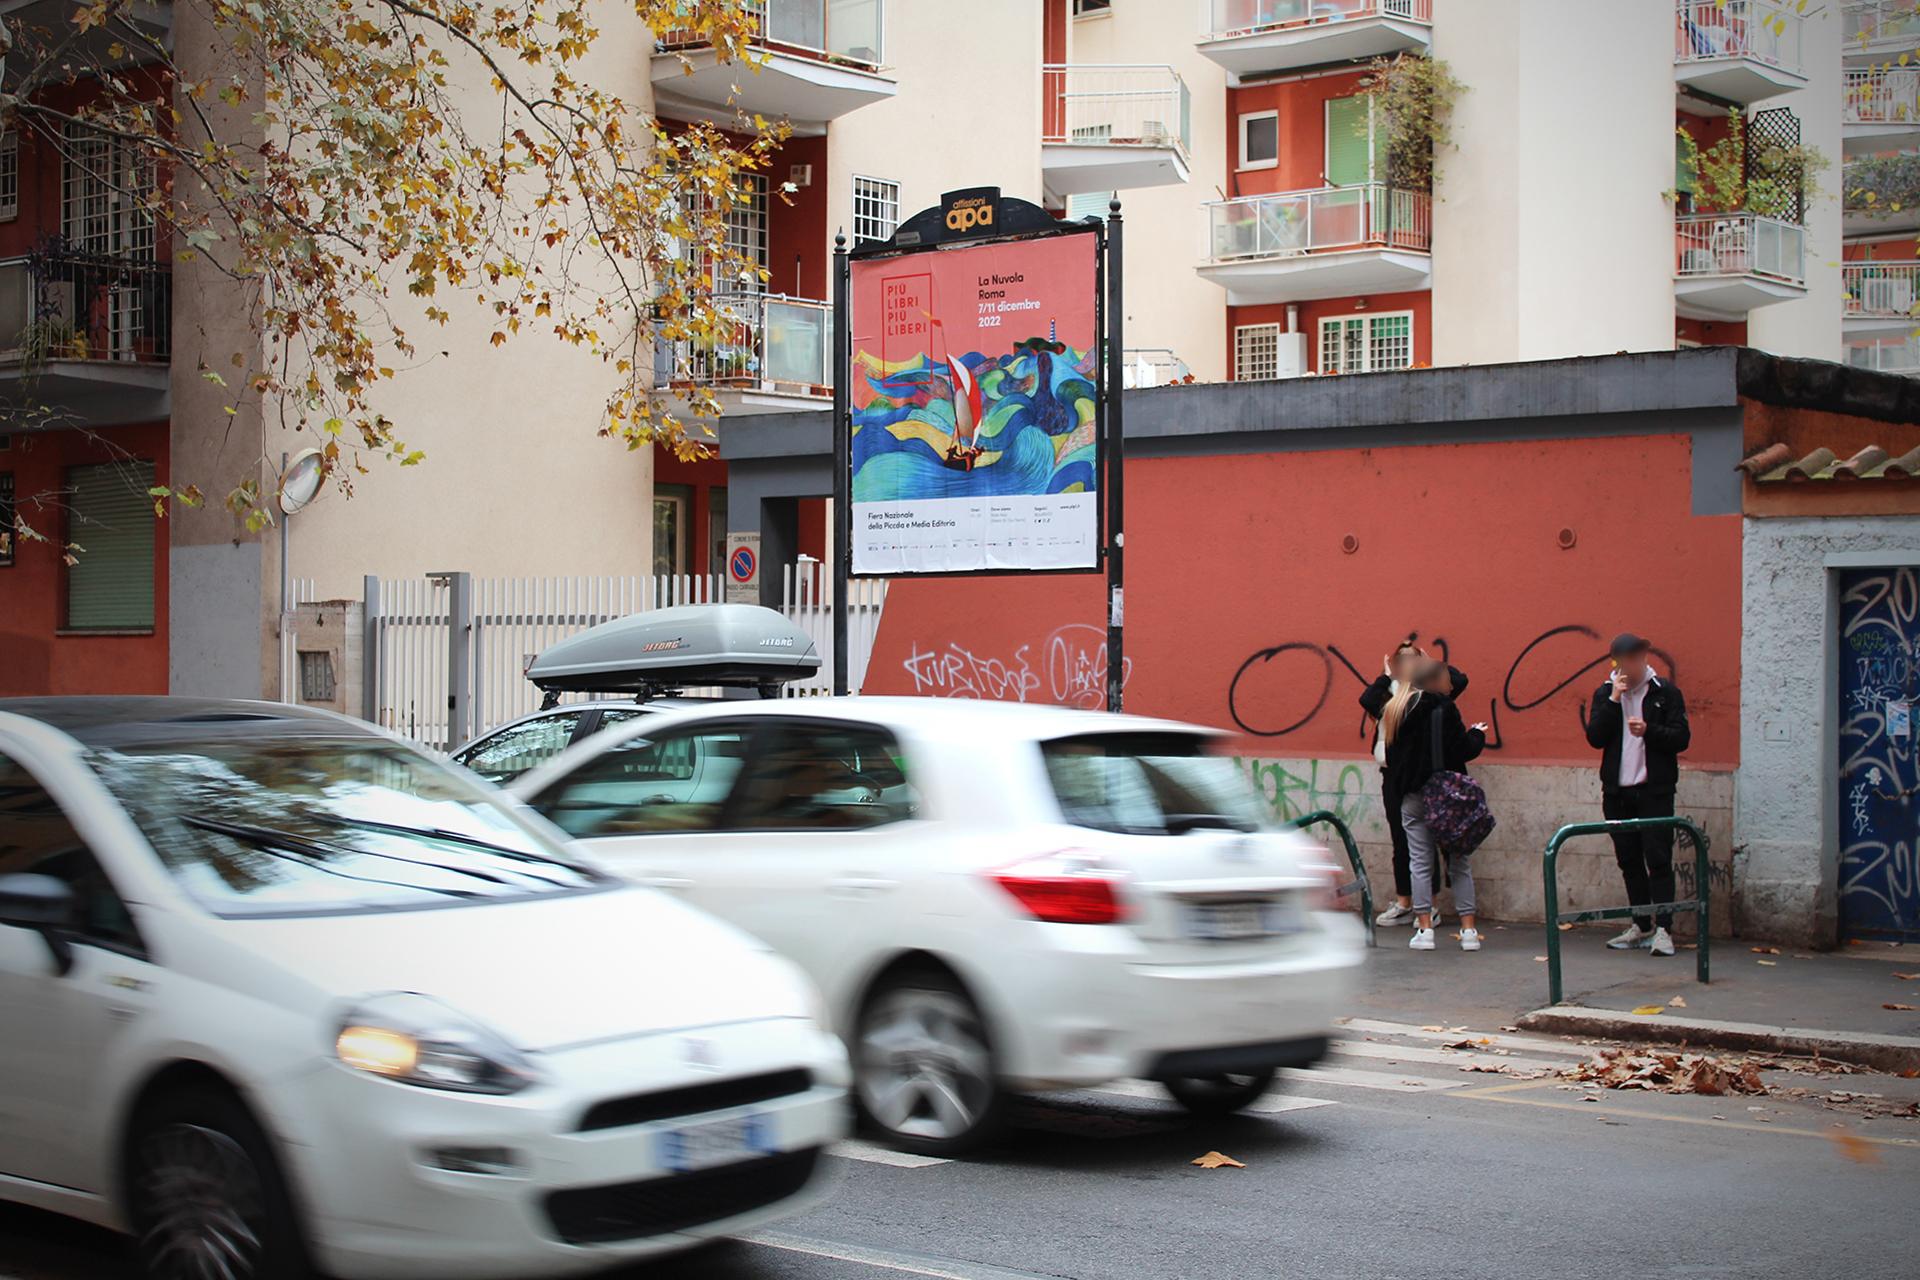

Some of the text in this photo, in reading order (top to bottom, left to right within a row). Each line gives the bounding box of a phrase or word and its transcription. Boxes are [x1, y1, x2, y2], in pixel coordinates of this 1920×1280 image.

[946, 205, 993, 232] apa
[978, 272, 1024, 286] La Nuvola
[887, 283, 907, 296] PIÙ
[978, 289, 1006, 299] Roma
[887, 297, 919, 309] LIBRI
[978, 299, 1041, 314] 7/11 dicembre
[887, 310, 907, 323] PIÙ
[978, 316, 1001, 328] 2022
[887, 323, 927, 336] LIBERI
[868, 511, 914, 520] Fiera Nazionale
[911, 520, 931, 528] Media
[932, 519, 956, 528] Editoria
